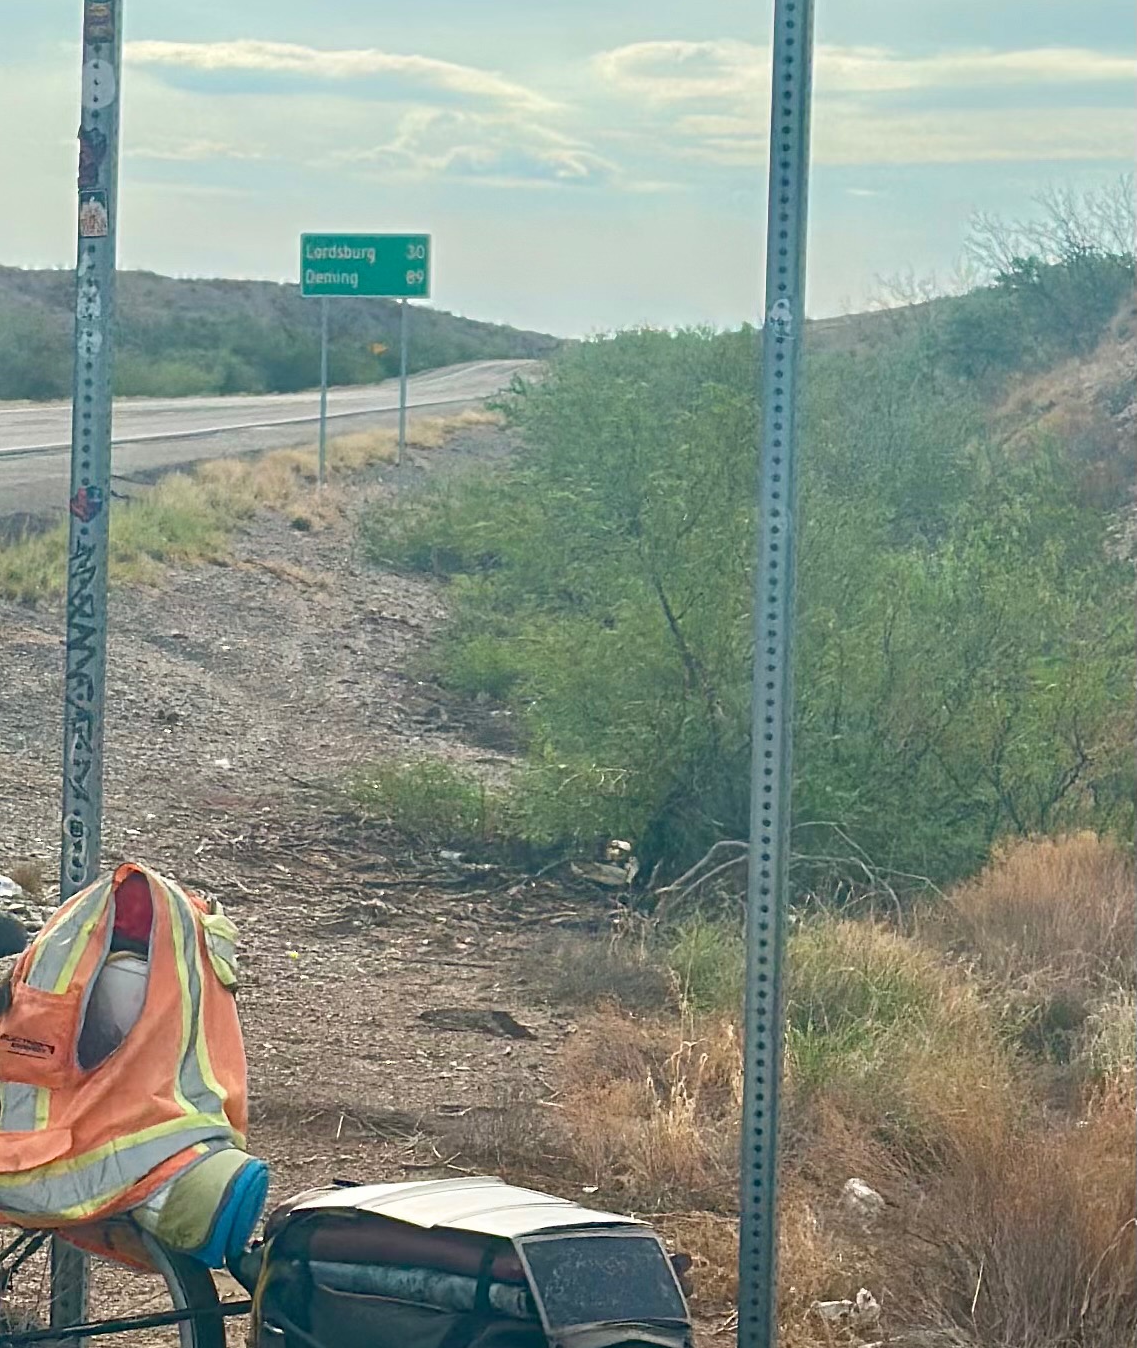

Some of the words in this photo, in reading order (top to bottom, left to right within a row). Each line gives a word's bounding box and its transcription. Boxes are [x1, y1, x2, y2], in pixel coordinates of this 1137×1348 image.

[305, 244, 376, 264] Lordsburg
[405, 244, 426, 259] 30
[305, 269, 359, 288] Deming
